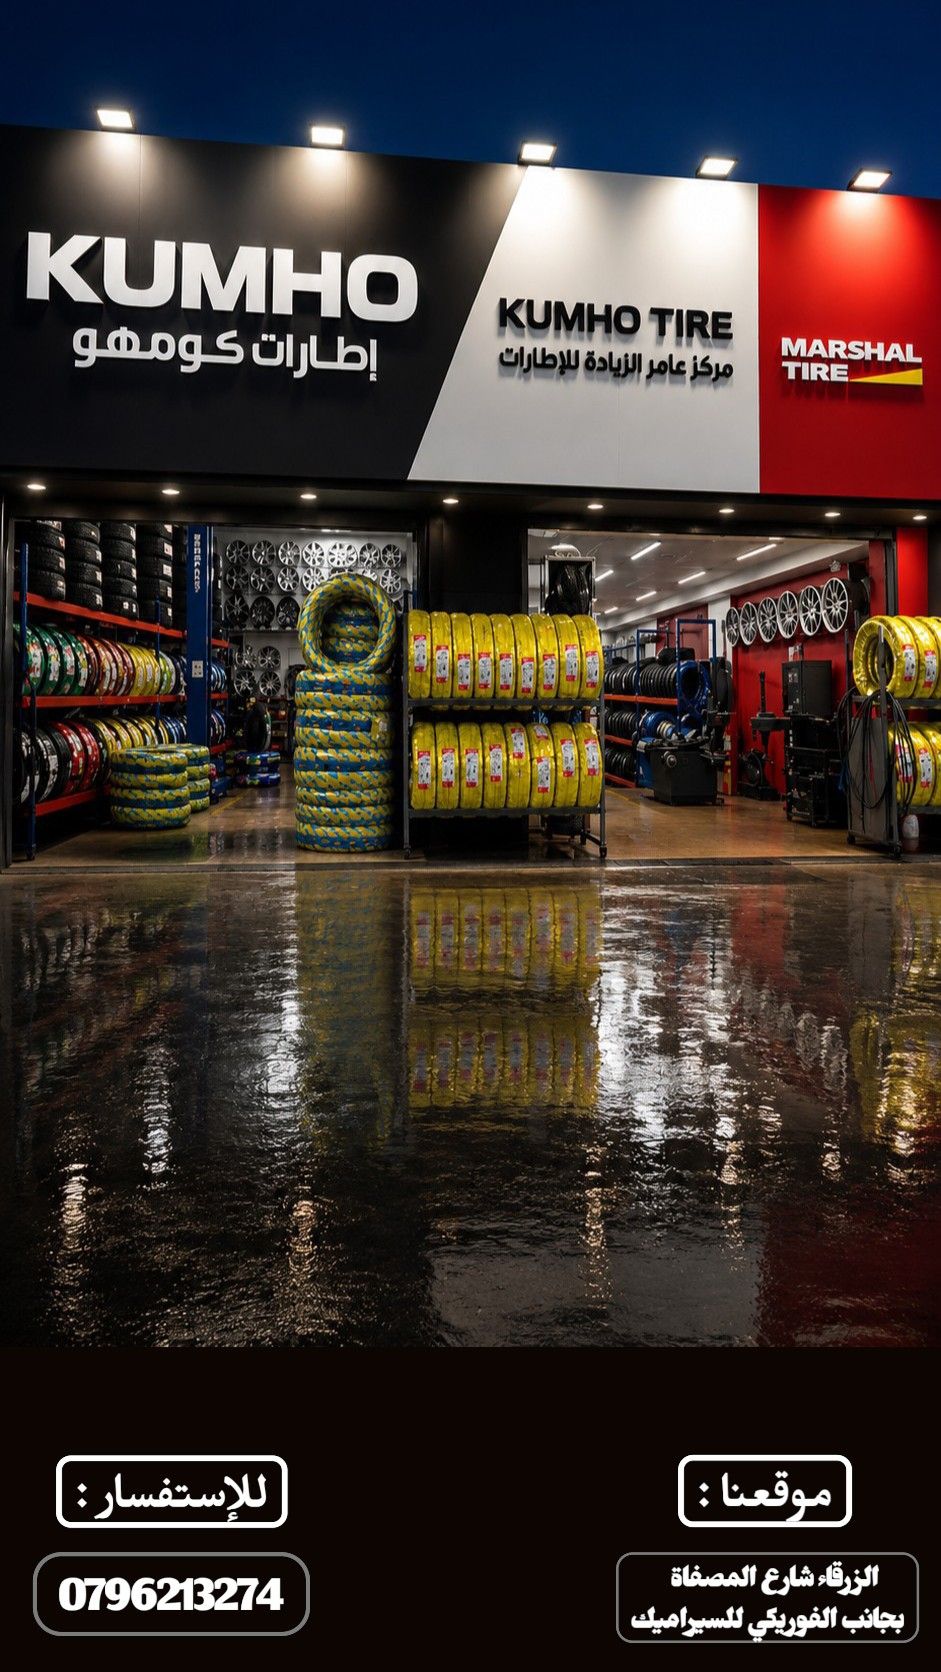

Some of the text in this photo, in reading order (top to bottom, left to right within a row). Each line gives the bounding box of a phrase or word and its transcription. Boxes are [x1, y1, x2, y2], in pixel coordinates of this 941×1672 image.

[27, 232, 418, 322] KUMHO
[499, 297, 733, 341] KUMHO TIRE
[72, 326, 377, 382] إطارات كومهو
[498, 346, 734, 383] مركز عامر الزيادة للإطارات
[781, 336, 922, 364] MARSHAL
[781, 361, 849, 382] TIRE
